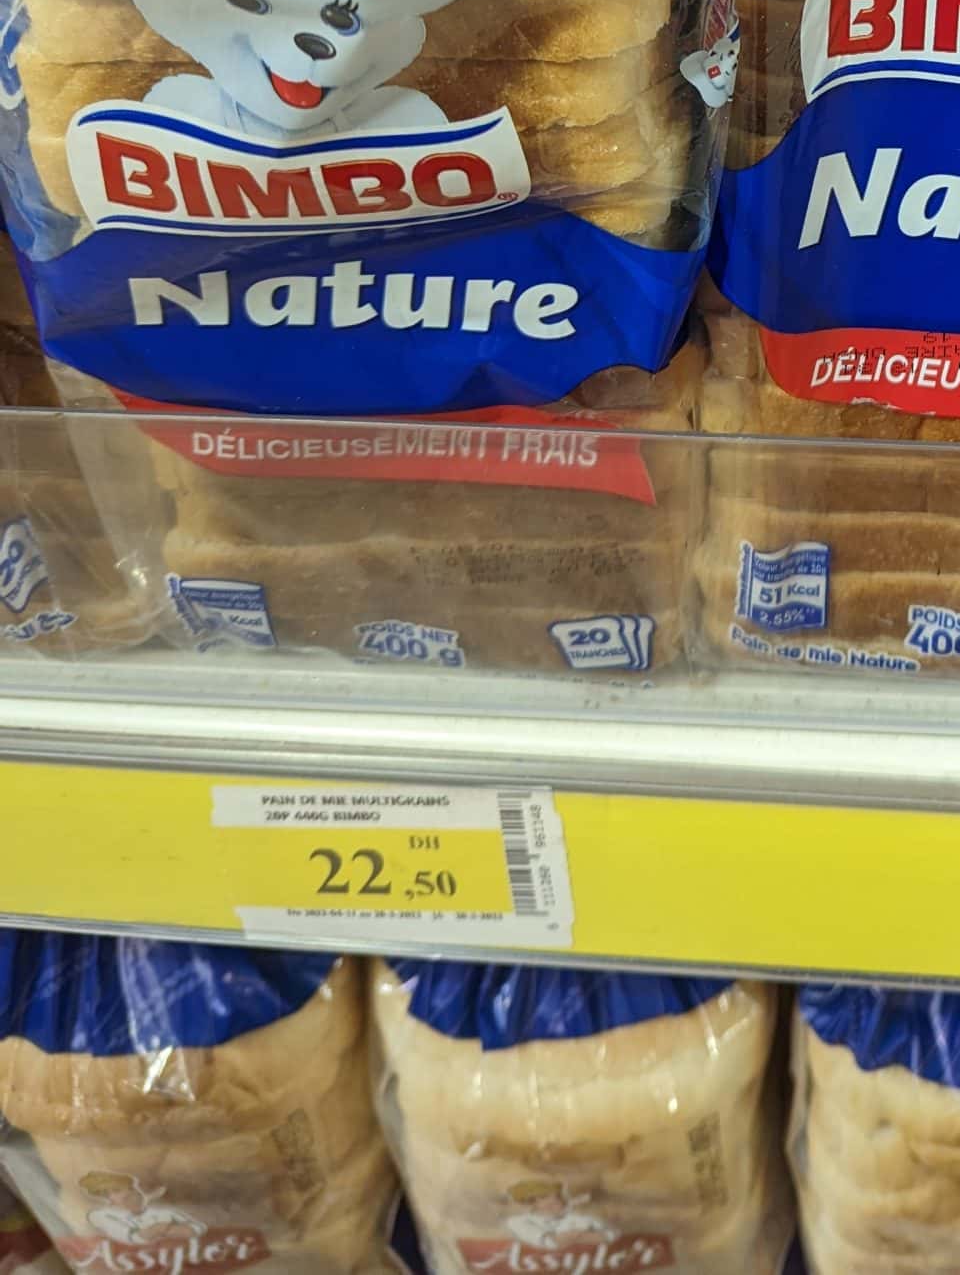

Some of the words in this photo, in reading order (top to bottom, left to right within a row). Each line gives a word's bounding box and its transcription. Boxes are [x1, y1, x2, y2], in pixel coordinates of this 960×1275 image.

[95, 132, 497, 218] BIMBO
[128, 260, 579, 339] Nature
[192, 429, 487, 464] DÉLICIEUSEMENT
[502, 436, 598, 467] FRAIS
[759, 587, 782, 603] 51
[787, 583, 820, 598] Kcal
[363, 633, 428, 658] 400
[440, 648, 462, 667] g
[421, 628, 455, 643] NET
[569, 628, 610, 646] 20
[731, 626, 769, 652] Pain
[809, 646, 843, 663] mie
[851, 652, 917, 671] Nature
[261, 794, 296, 806] PAIN
[308, 848, 392, 895] 22
